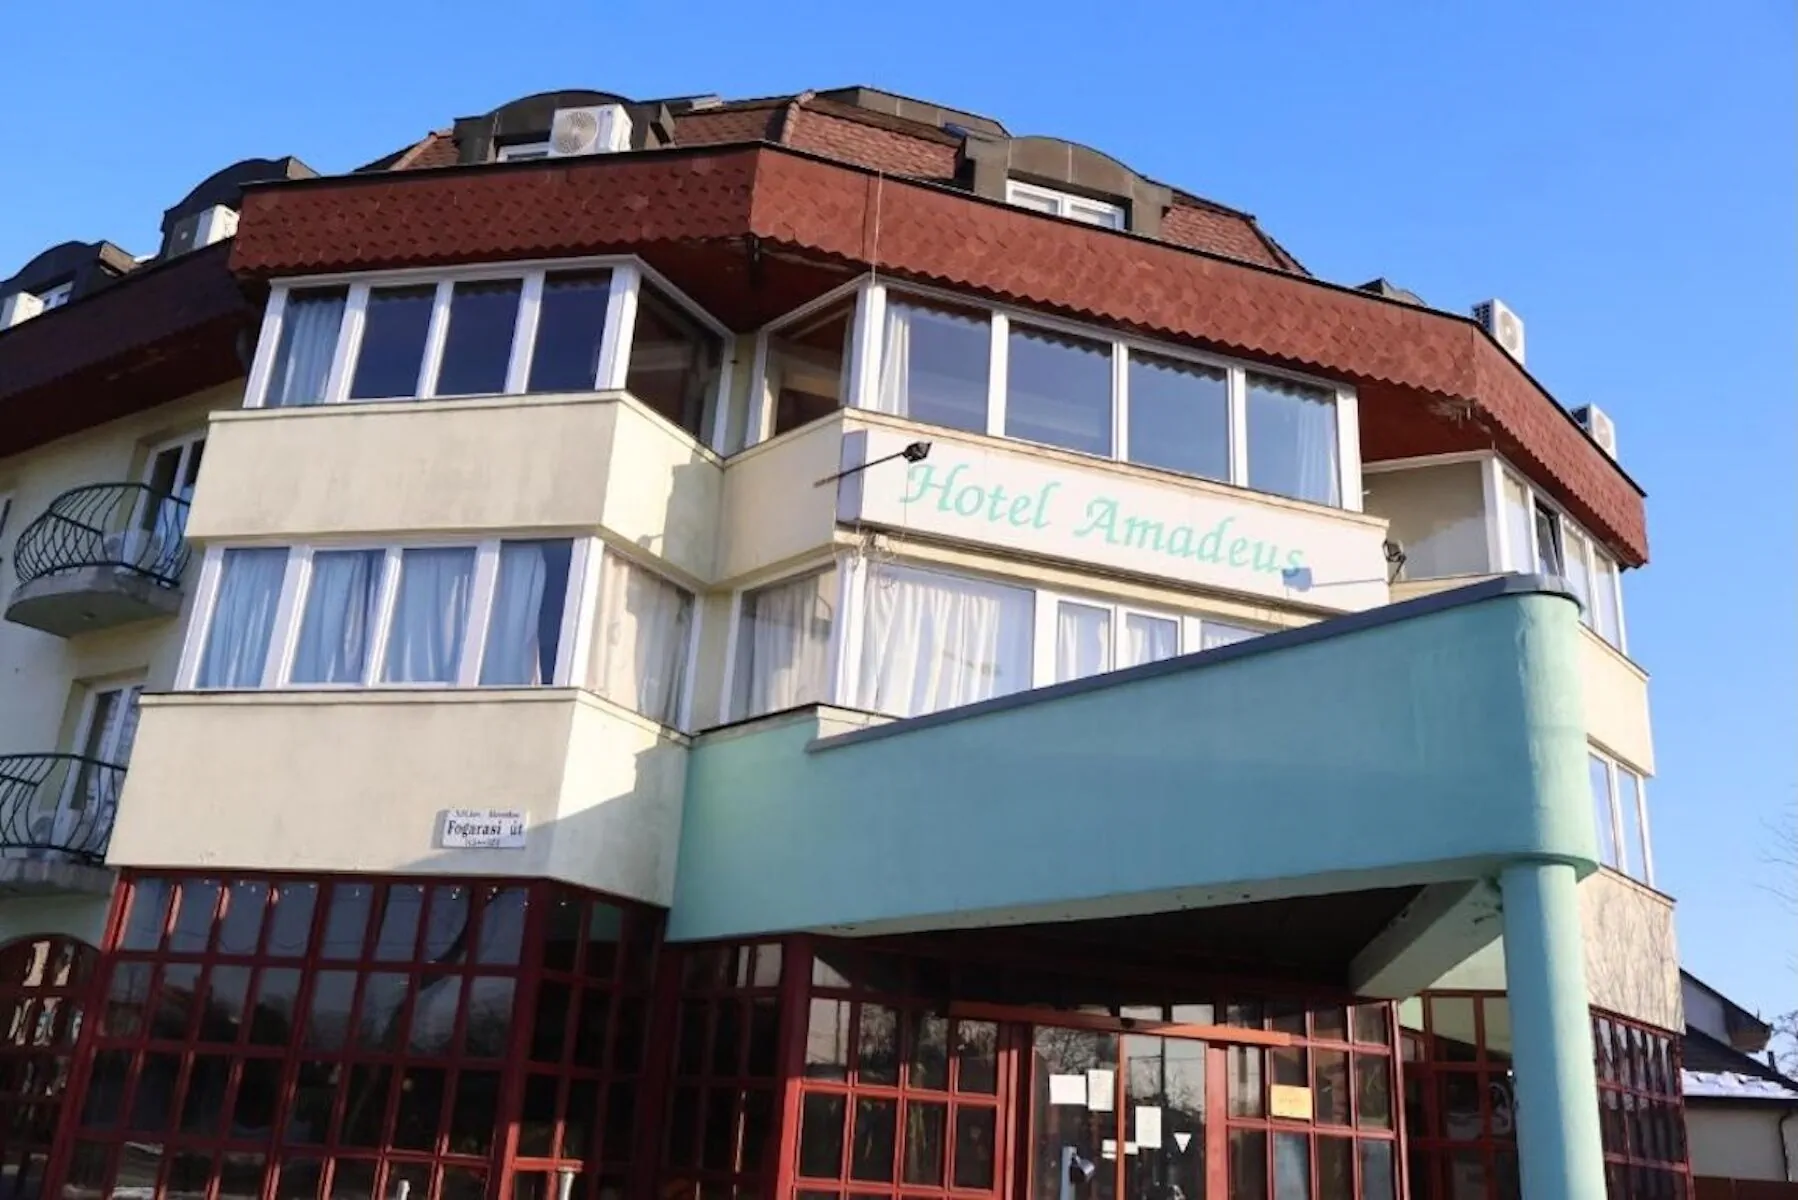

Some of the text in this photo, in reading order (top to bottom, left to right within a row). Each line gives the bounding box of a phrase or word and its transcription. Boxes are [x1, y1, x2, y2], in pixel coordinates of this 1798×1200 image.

[900, 463, 1304, 577] Hotel Amadeus
[447, 819, 523, 837] Fogarasi út
